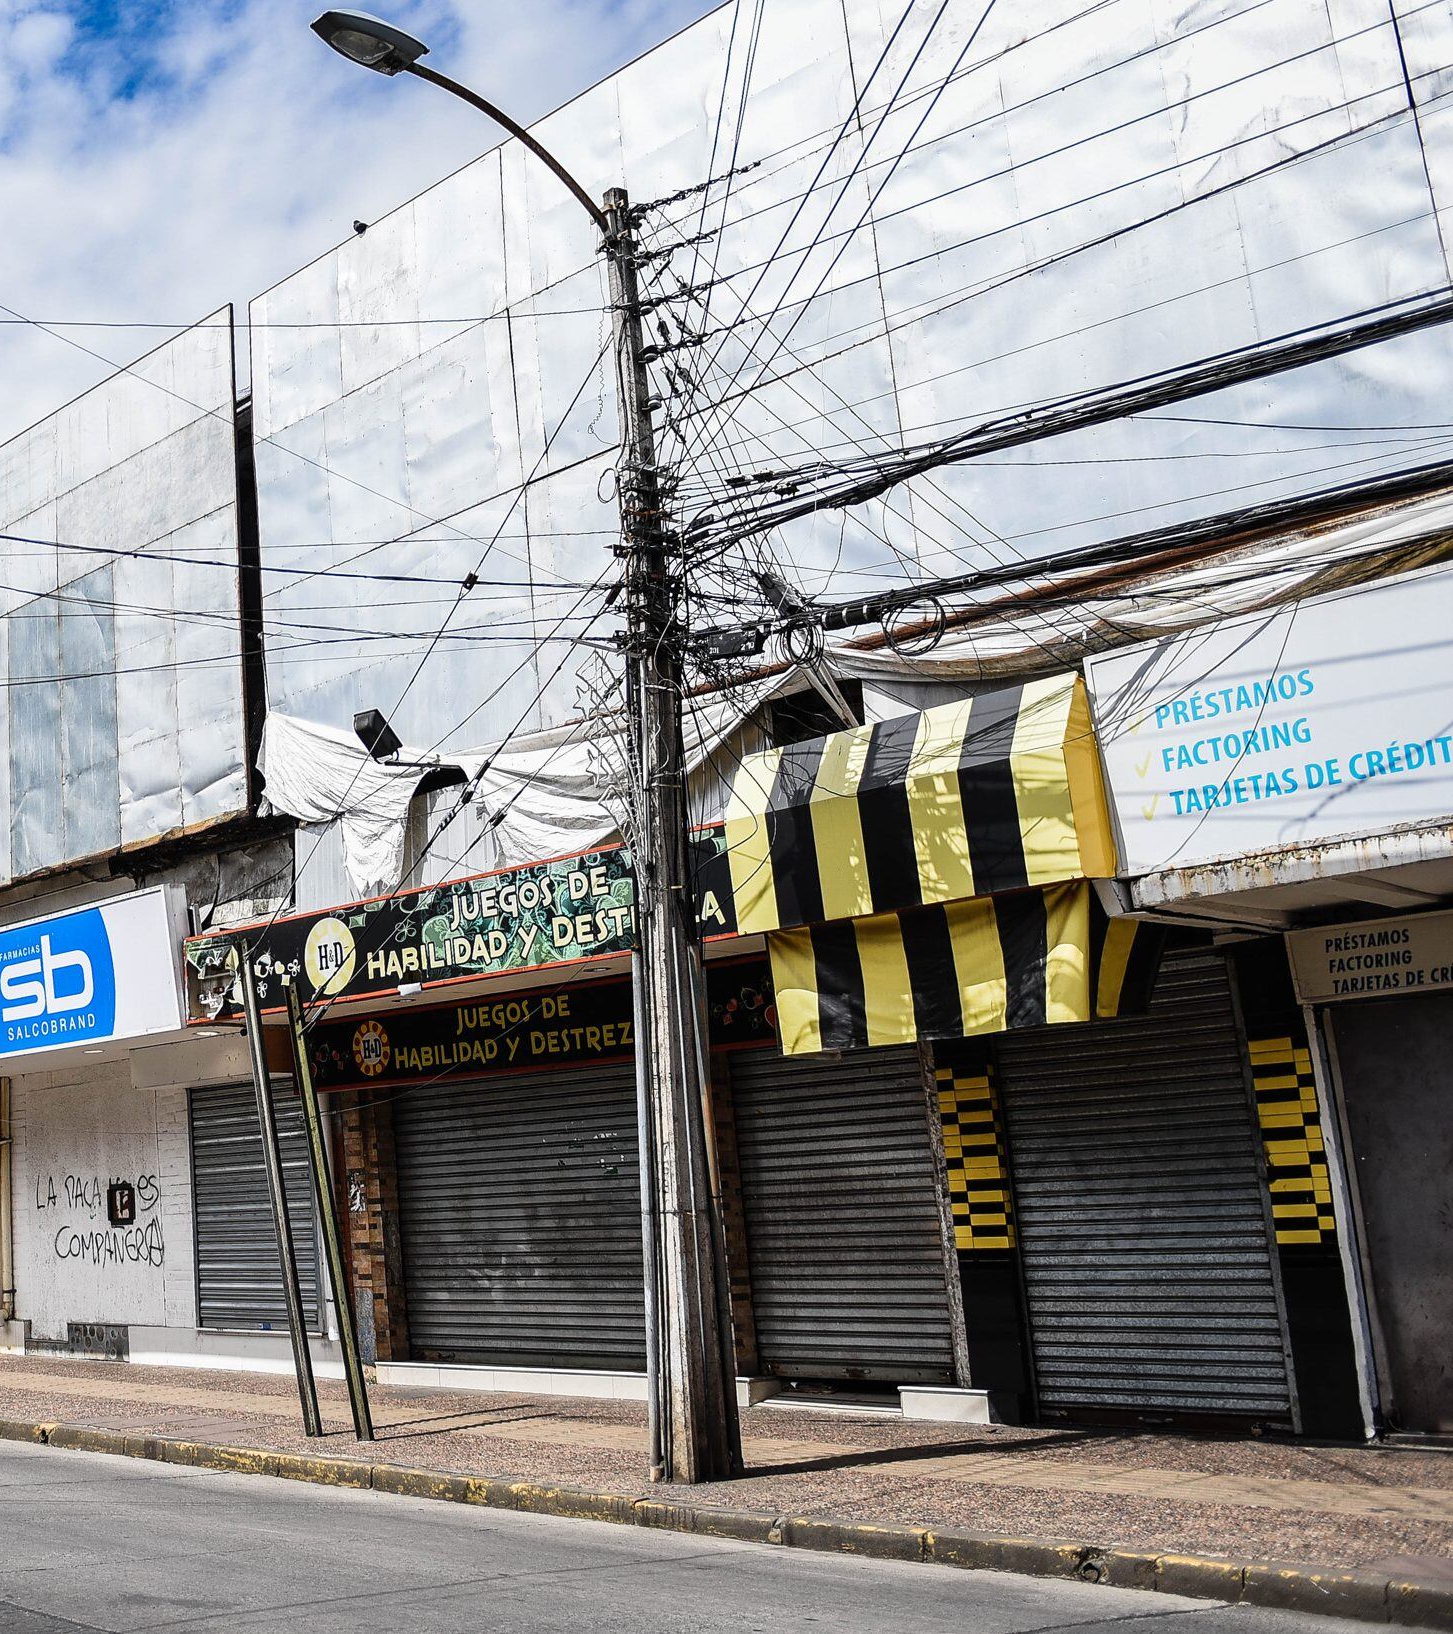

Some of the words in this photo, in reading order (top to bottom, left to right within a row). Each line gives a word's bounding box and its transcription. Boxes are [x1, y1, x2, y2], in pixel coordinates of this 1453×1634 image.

[1155, 669, 1315, 729] PRÉSTAMOS
[1162, 717, 1312, 772] FACTORING
[1169, 768, 1298, 815] TARJETAS
[1305, 758, 1342, 790] DE
[450, 877, 553, 930] JUEGOS
[569, 866, 609, 900] DE
[0, 944, 40, 961] FARMACIAS
[366, 931, 508, 980] HABILIDAD
[517, 923, 536, 960] Y
[1325, 929, 1409, 953] PRÉSTAMOS
[1329, 950, 1412, 974] FACTORING
[0, 934, 94, 1022] sb
[1332, 972, 1399, 993] TARJETAS
[1406, 970, 1424, 985] DE
[8, 1013, 96, 1041] SALCOBRAND
[457, 1000, 529, 1035] JUEGOS
[542, 995, 570, 1019] DE
[395, 1038, 497, 1071] HABILIDAD
[506, 1036, 519, 1061] Y
[531, 1021, 634, 1055] DESTREZ
[36, 1175, 57, 1209] LA
